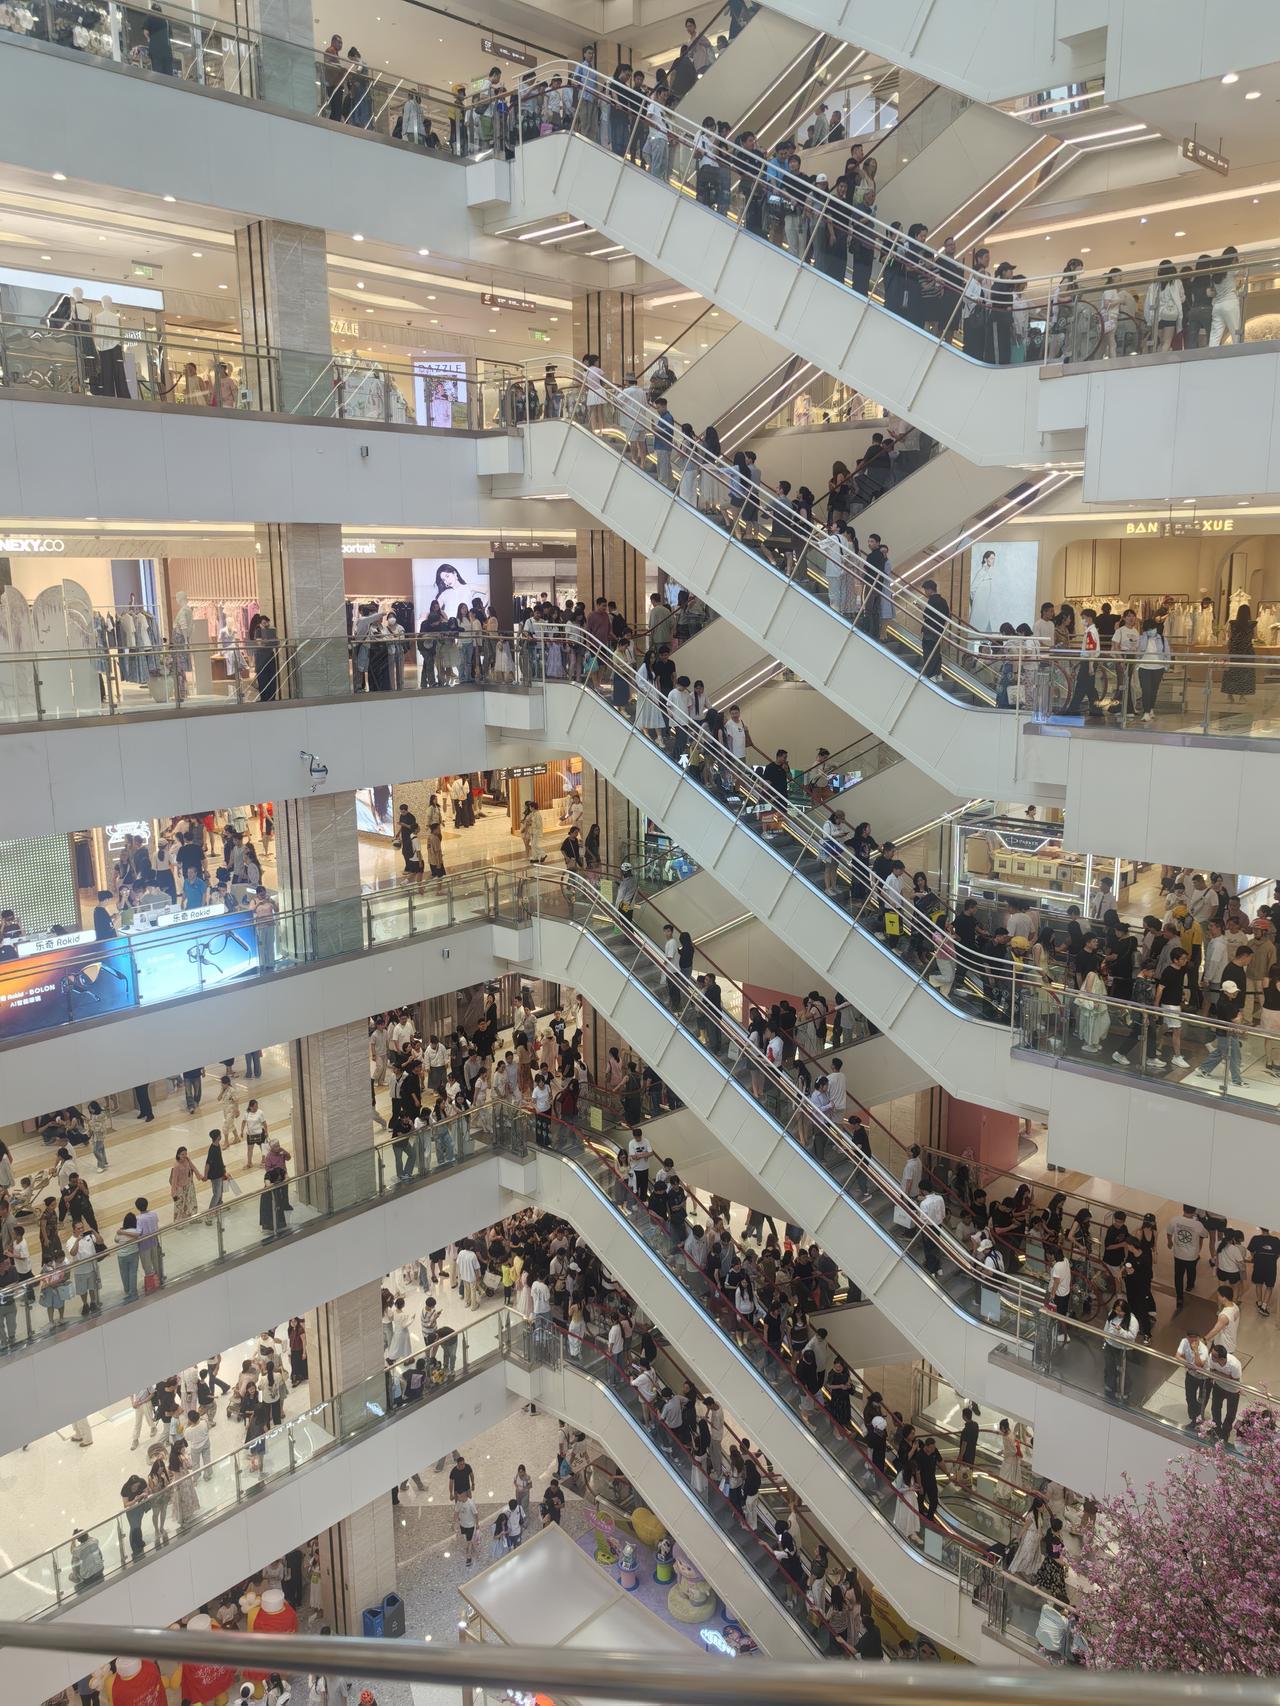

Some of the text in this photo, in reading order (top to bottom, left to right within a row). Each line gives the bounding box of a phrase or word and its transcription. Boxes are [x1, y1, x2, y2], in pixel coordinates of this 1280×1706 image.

[1126, 522, 1159, 534] BAN
[1202, 519, 1235, 531] XUE
[190, 908, 211, 919] Rokid
[56, 935, 80, 947] Rokid
